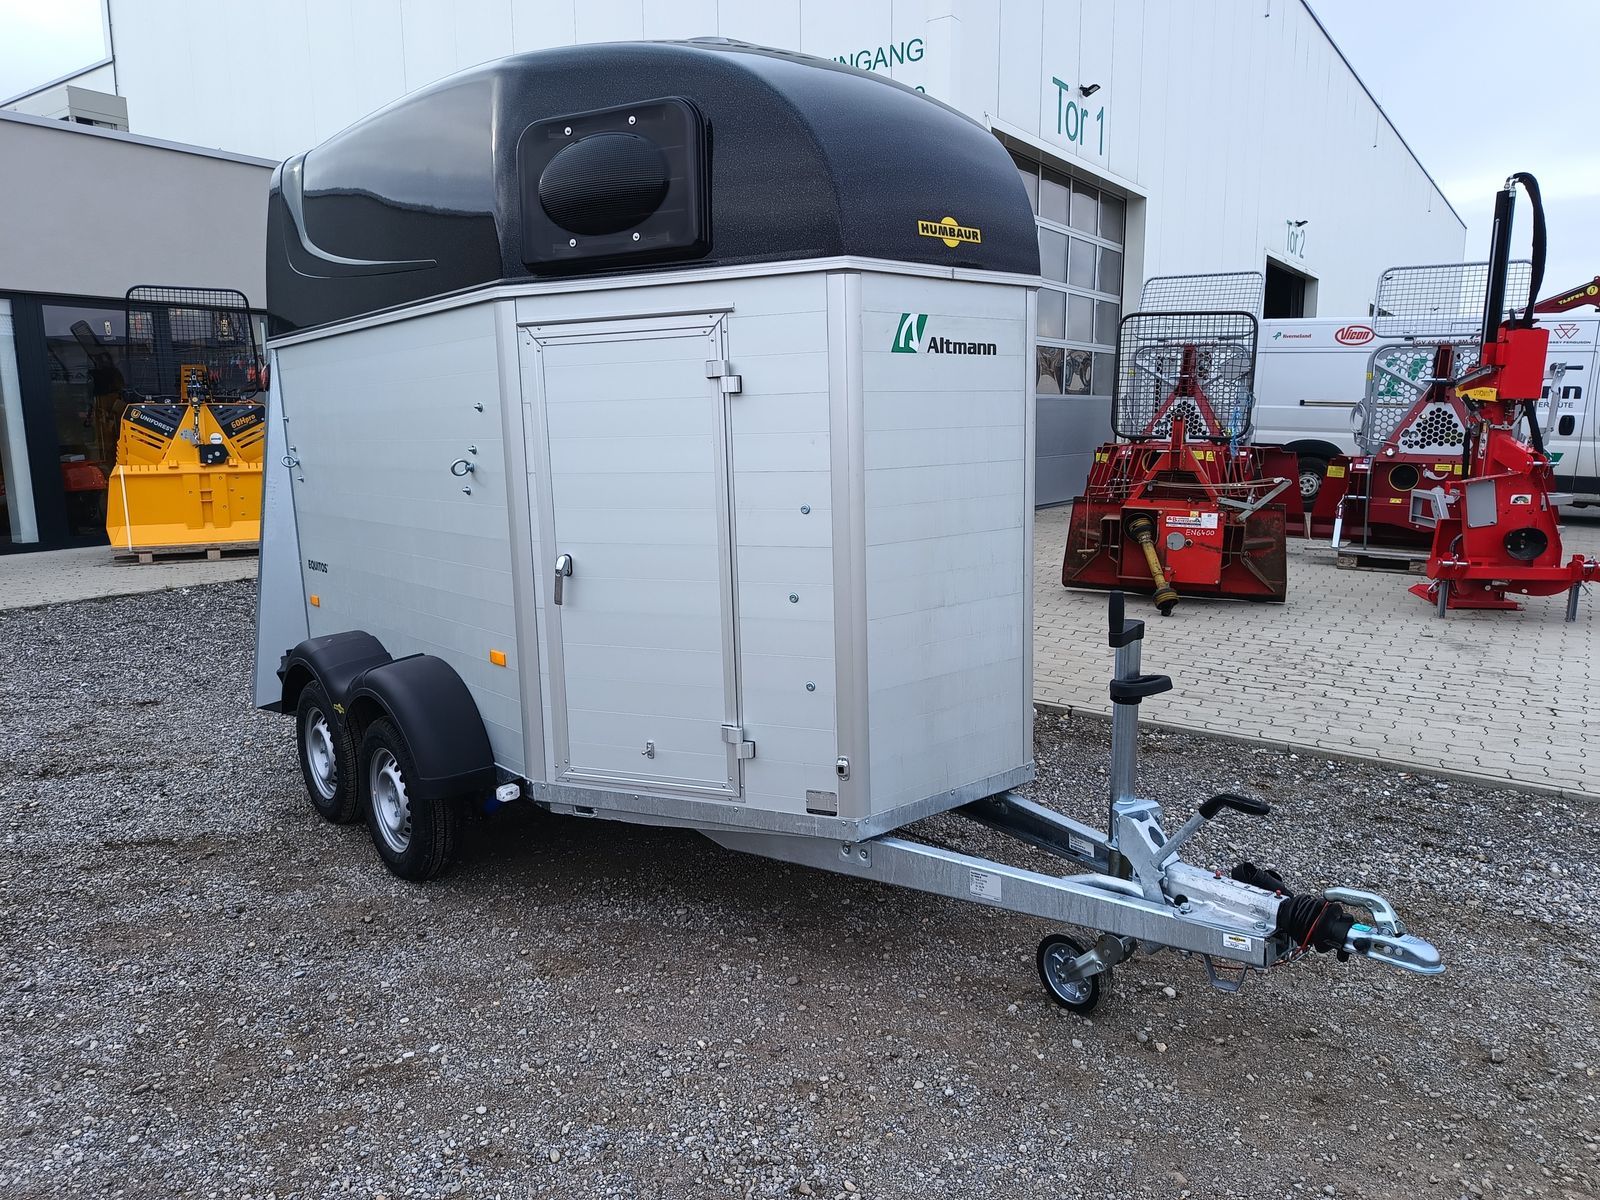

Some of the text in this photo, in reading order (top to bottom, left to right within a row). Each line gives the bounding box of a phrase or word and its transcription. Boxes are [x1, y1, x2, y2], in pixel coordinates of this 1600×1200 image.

[1052, 76, 1104, 156] Tor 1
[920, 222, 980, 241] HUMBAUR
[1286, 219, 1306, 259] Tor 2
[1340, 327, 1371, 340] Vicon
[927, 336, 997, 356] Altmann
[140, 414, 174, 433] UNIFOREST
[1185, 529, 1215, 537] EN6400
